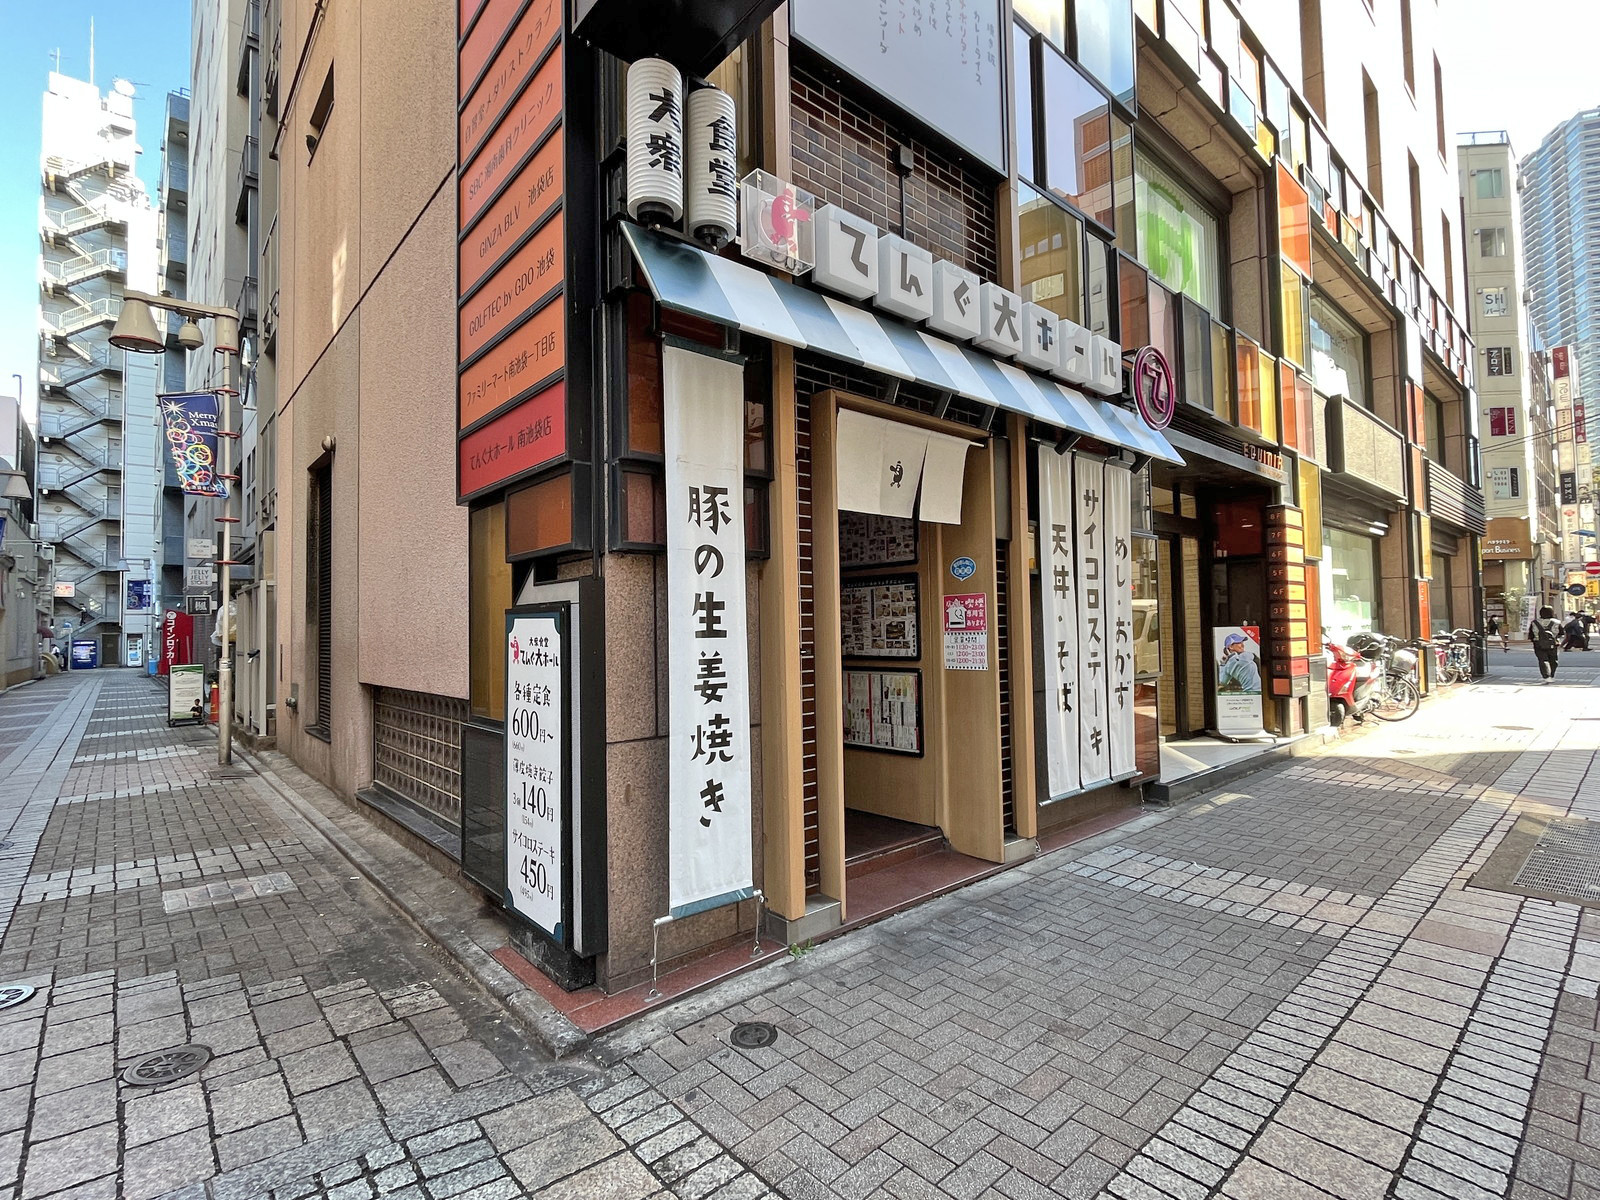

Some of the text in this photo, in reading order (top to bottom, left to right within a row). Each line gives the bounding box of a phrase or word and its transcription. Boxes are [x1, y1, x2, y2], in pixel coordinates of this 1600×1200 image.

[645, 87, 683, 178] 大衆
[480, 165, 554, 258] GINZA BLV 池袋店
[469, 247, 555, 336] GOLFTEC by GDO 池袋
[840, 220, 1117, 378] てんぐ大ホール
[188, 412, 217, 421] Merry
[191, 419, 218, 427] Xmas
[517, 416, 552, 450] 南池袋店
[166, 619, 177, 665] コインロッカー
[529, 636, 549, 648] 大衆食堂
[1083, 488, 1103, 757] サイコロステーキ
[520, 648, 559, 667] てんぐ大ホール
[687, 484, 734, 828] 豚の生姜焼き
[514, 680, 551, 707] 各種定食
[522, 781, 554, 823] 140円
[512, 829, 555, 865] サイコロステーキ
[520, 855, 554, 901] 450円
